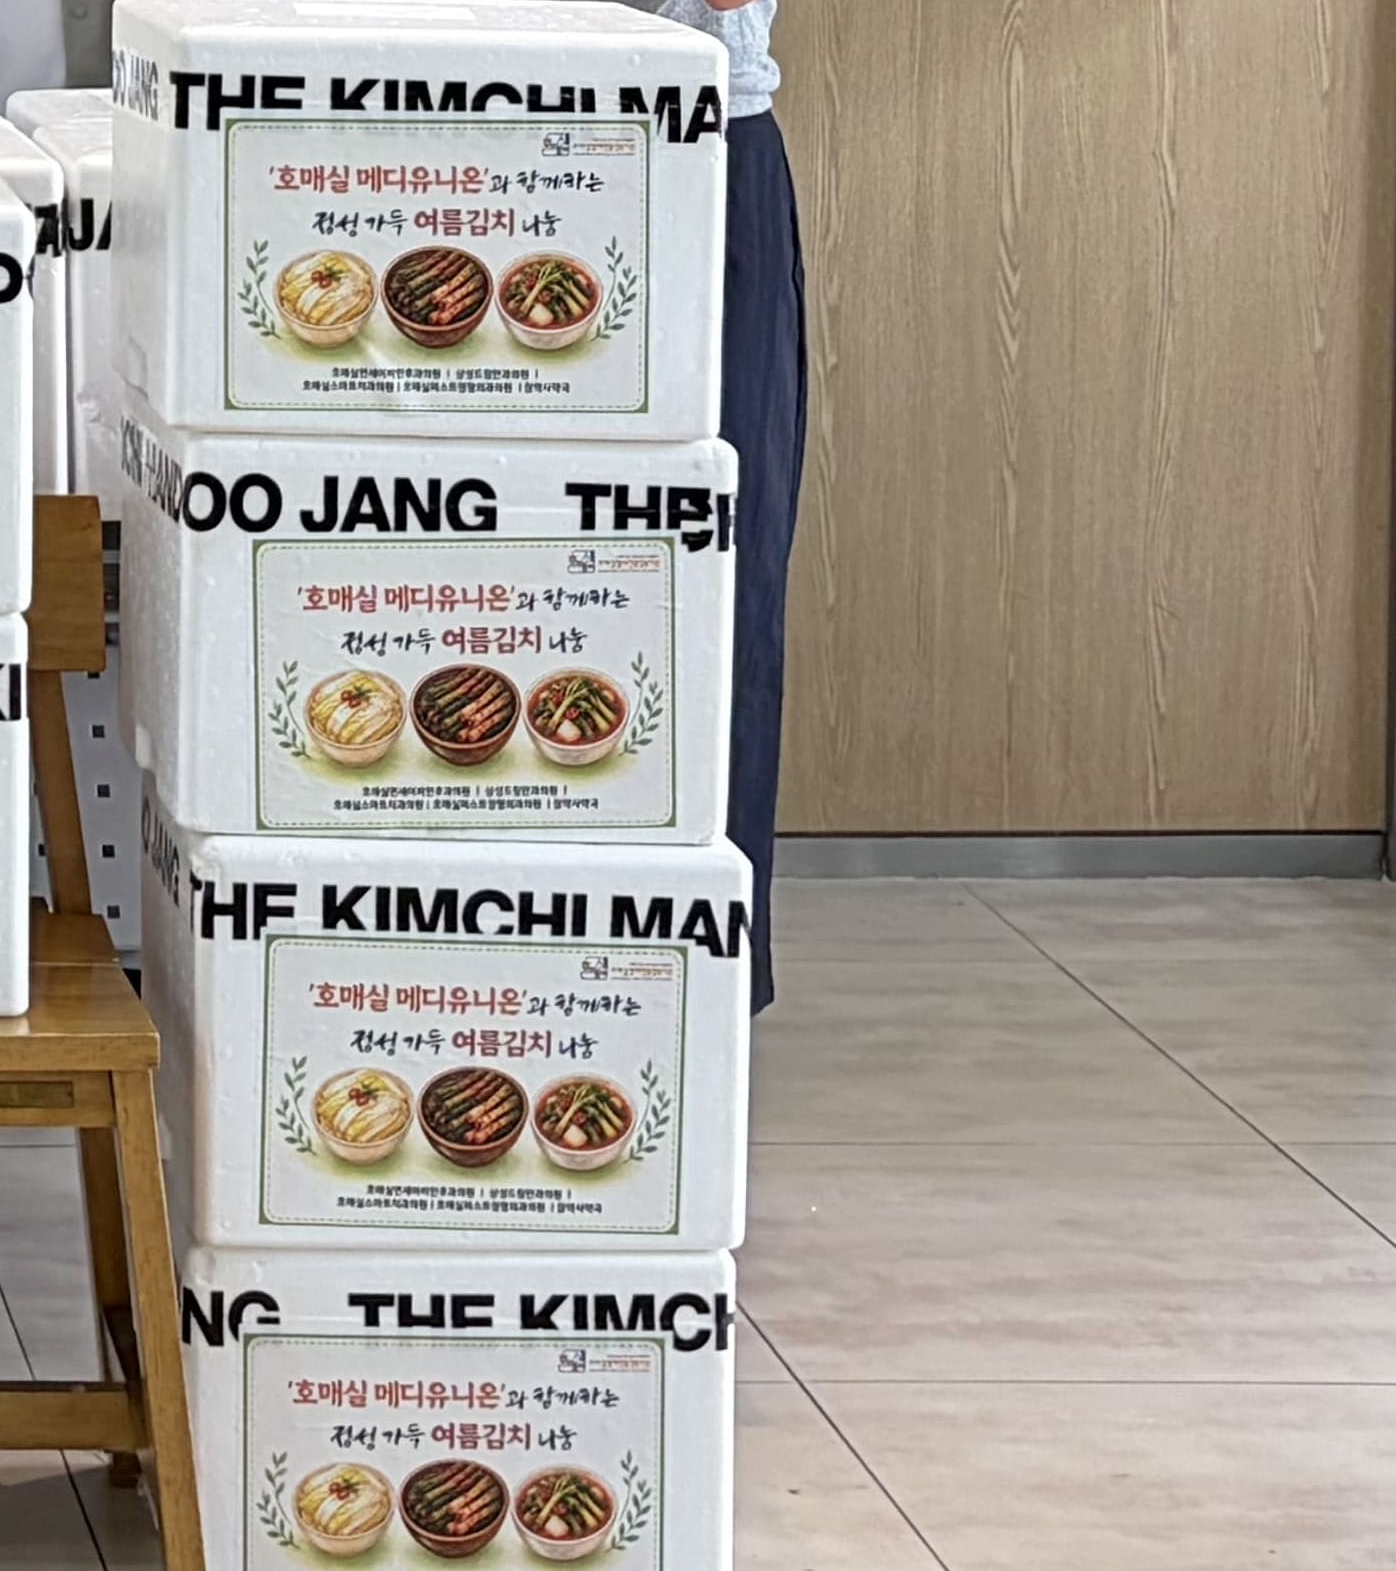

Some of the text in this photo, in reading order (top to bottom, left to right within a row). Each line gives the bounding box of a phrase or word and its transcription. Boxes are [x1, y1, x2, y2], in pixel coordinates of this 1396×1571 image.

[311, 211, 360, 238] 정성
[413, 207, 515, 237] 여름김치
[300, 475, 498, 533] JANG
[340, 630, 388, 658] 정성
[441, 625, 542, 655] 여름김치
[322, 883, 588, 938] KIMCHI
[349, 1029, 399, 1057] 정성
[451, 1028, 552, 1059] 여름김치
[330, 1424, 378, 1451] 정성
[430, 1422, 531, 1451] 여름김치
